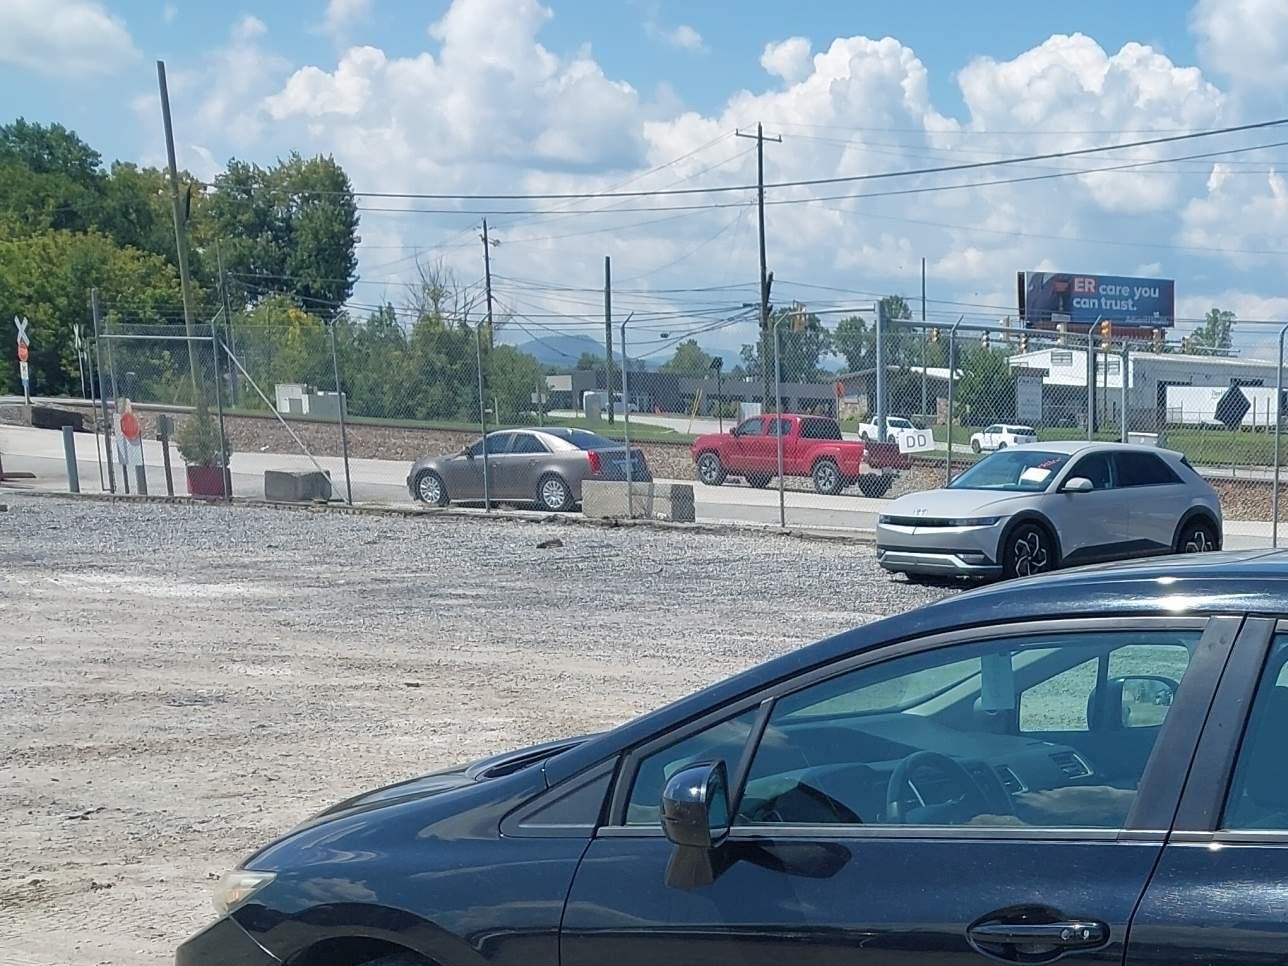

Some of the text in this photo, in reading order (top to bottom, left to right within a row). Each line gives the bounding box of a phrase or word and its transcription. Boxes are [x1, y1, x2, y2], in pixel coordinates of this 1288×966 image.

[1074, 278, 1159, 300] ER care you
[1073, 297, 1137, 311] can trust.
[906, 434, 927, 448] DD
